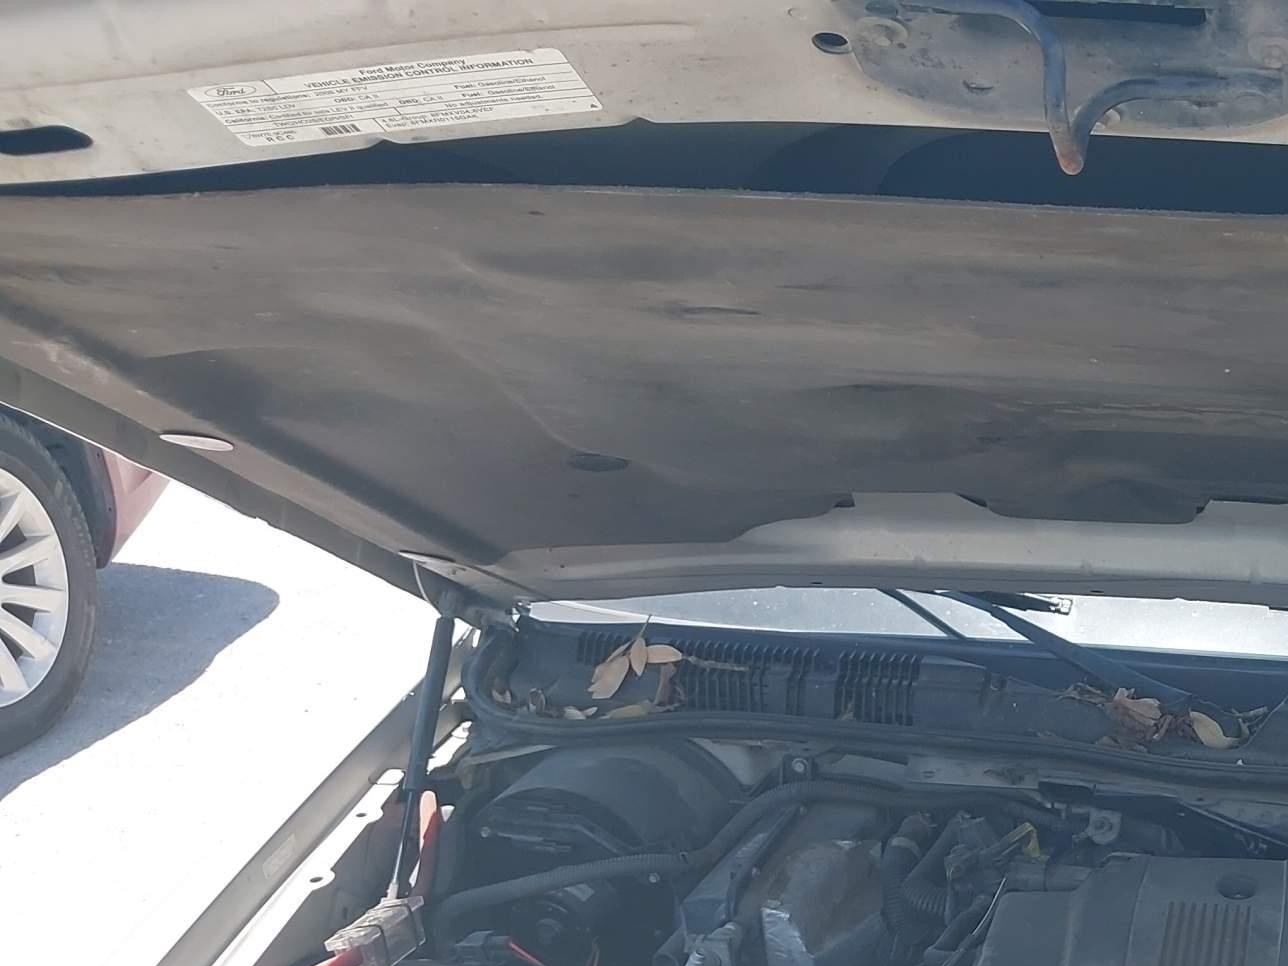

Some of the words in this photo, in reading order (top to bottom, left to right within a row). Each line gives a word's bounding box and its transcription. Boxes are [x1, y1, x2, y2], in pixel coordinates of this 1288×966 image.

[304, 78, 351, 89] VEHICLE
[352, 72, 403, 83] EMISSION
[405, 67, 457, 77] CONTROL
[459, 58, 534, 71] INFORMATION
[359, 67, 383, 76] Ford
[385, 64, 414, 72] Motor
[416, 59, 467, 69] Company
